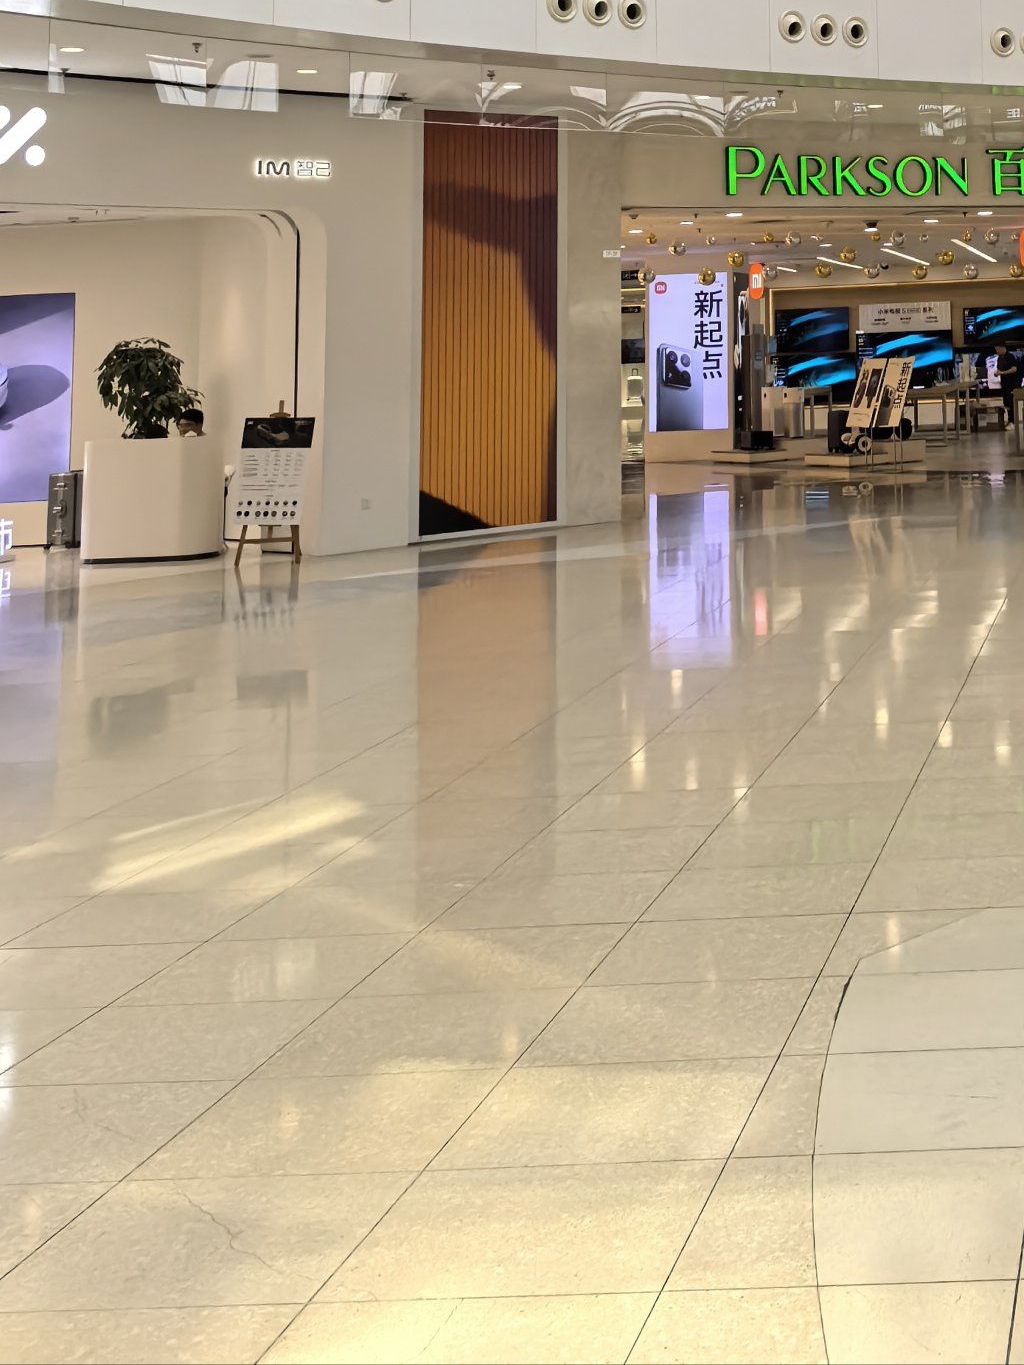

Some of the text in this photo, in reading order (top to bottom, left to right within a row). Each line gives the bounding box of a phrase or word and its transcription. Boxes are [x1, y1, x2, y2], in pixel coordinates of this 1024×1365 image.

[257, 160, 290, 176] IM
[726, 145, 970, 197] PARKSON
[693, 290, 724, 380] 新起点
